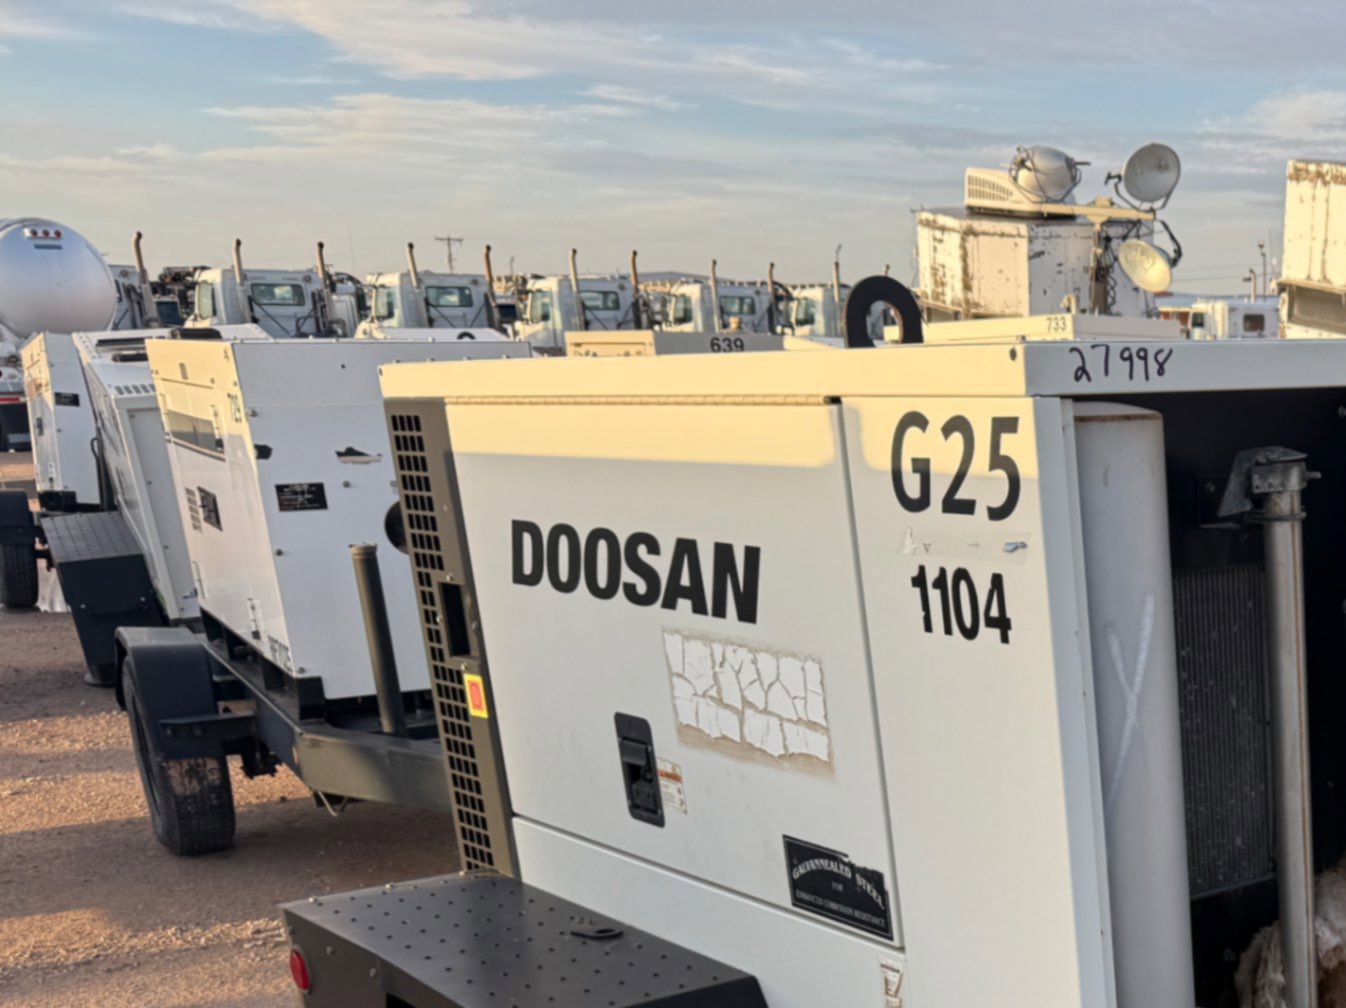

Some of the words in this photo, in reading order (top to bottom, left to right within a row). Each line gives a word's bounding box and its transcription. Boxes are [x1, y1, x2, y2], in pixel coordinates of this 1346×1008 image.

[1046, 316, 1066, 332] 733
[710, 336, 745, 353] 639
[1069, 344, 1173, 383] 27998
[890, 411, 1021, 522] G25
[511, 519, 761, 625] DOOSAN
[910, 564, 1012, 645] 1104
[856, 873, 885, 910] STEEL
